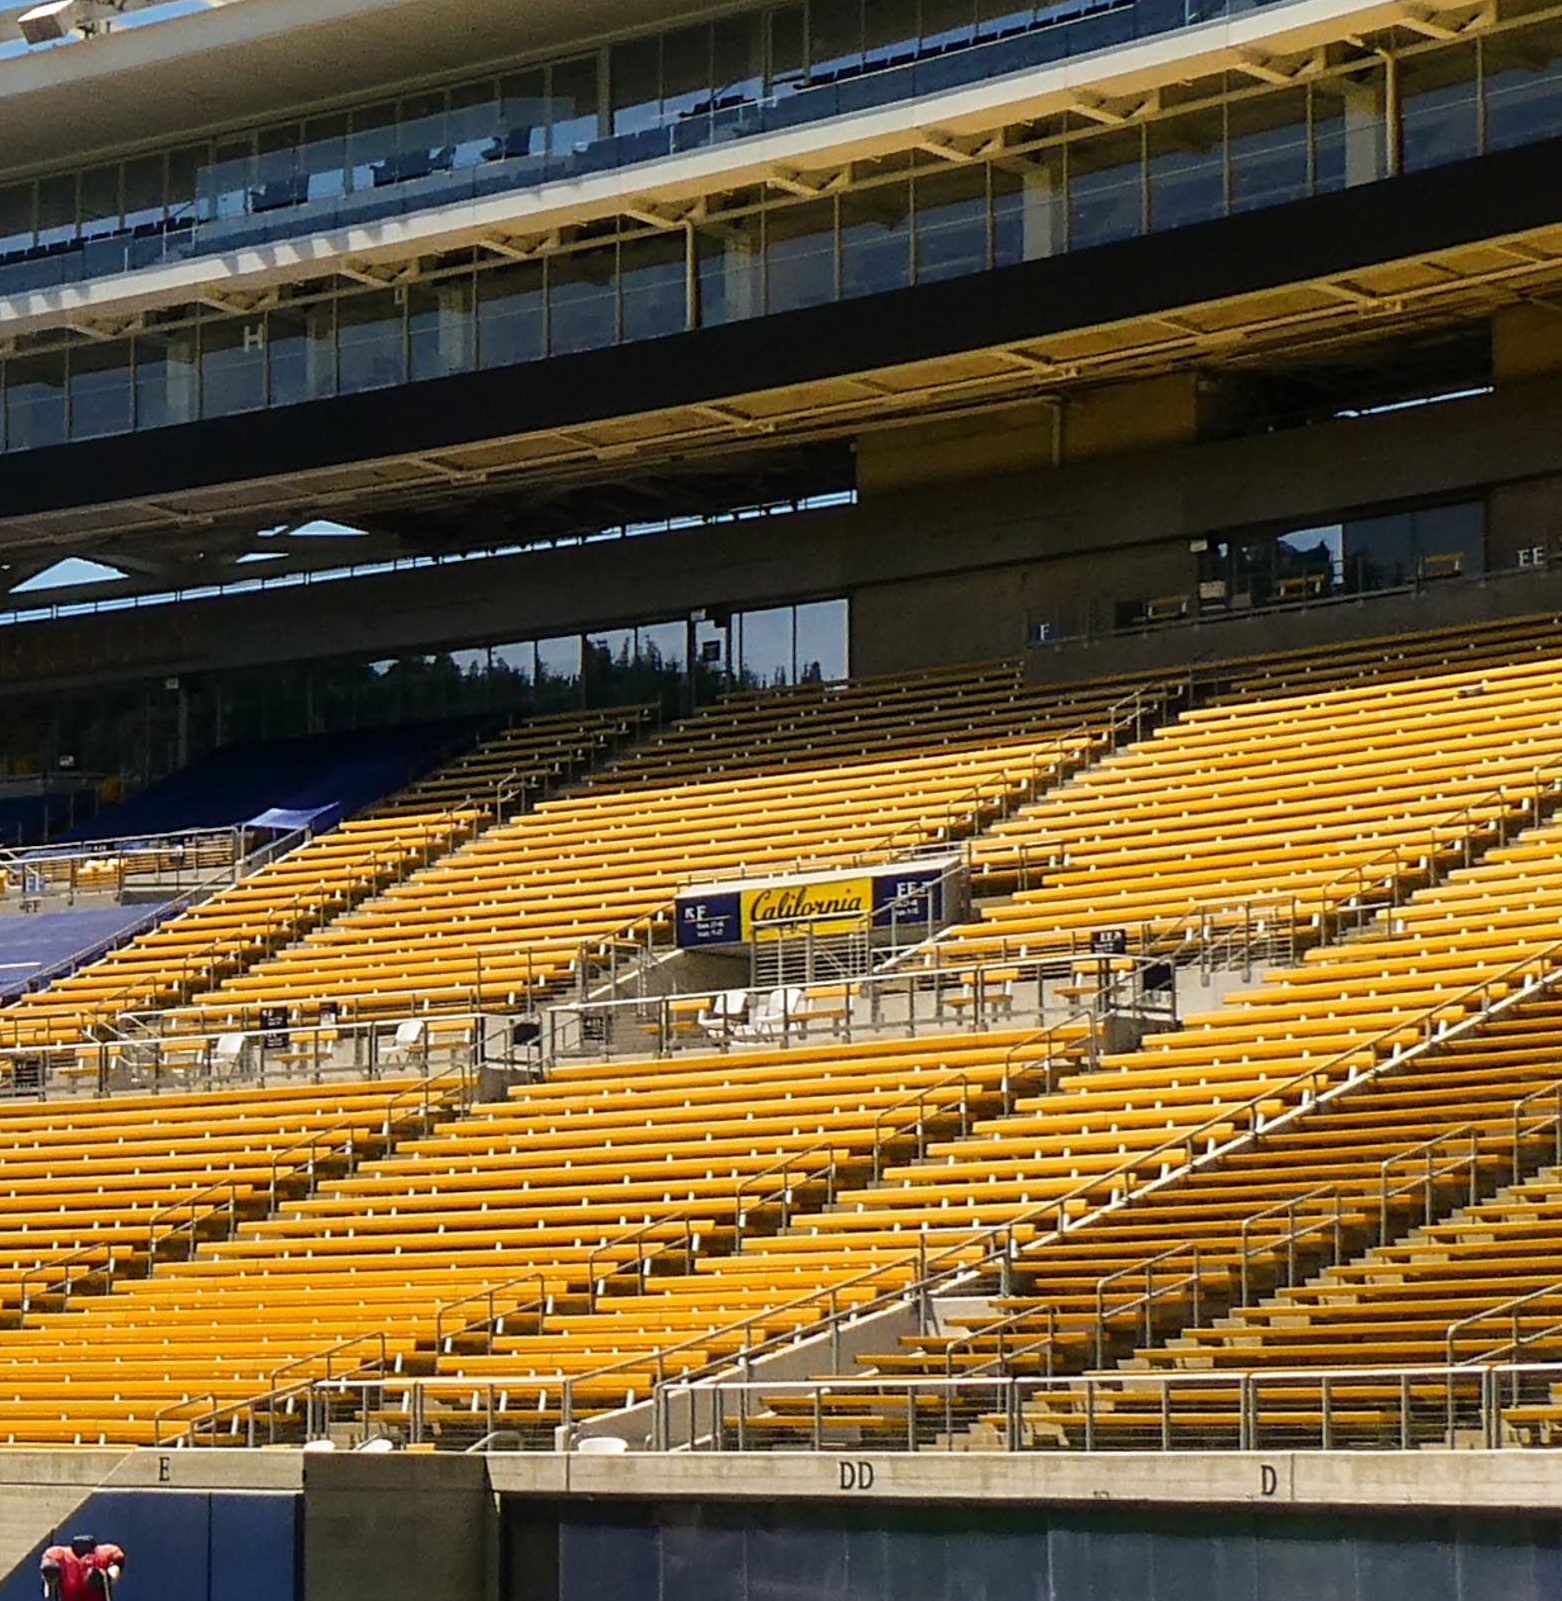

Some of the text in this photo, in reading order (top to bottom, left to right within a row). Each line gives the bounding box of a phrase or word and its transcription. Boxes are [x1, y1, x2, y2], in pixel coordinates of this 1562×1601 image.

[244, 323, 264, 352] H
[1516, 546, 1545, 567] EE
[750, 885, 863, 925] California
[158, 1457, 170, 1482] E
[839, 1462, 874, 1490] DD
[1260, 1464, 1277, 1496] D
